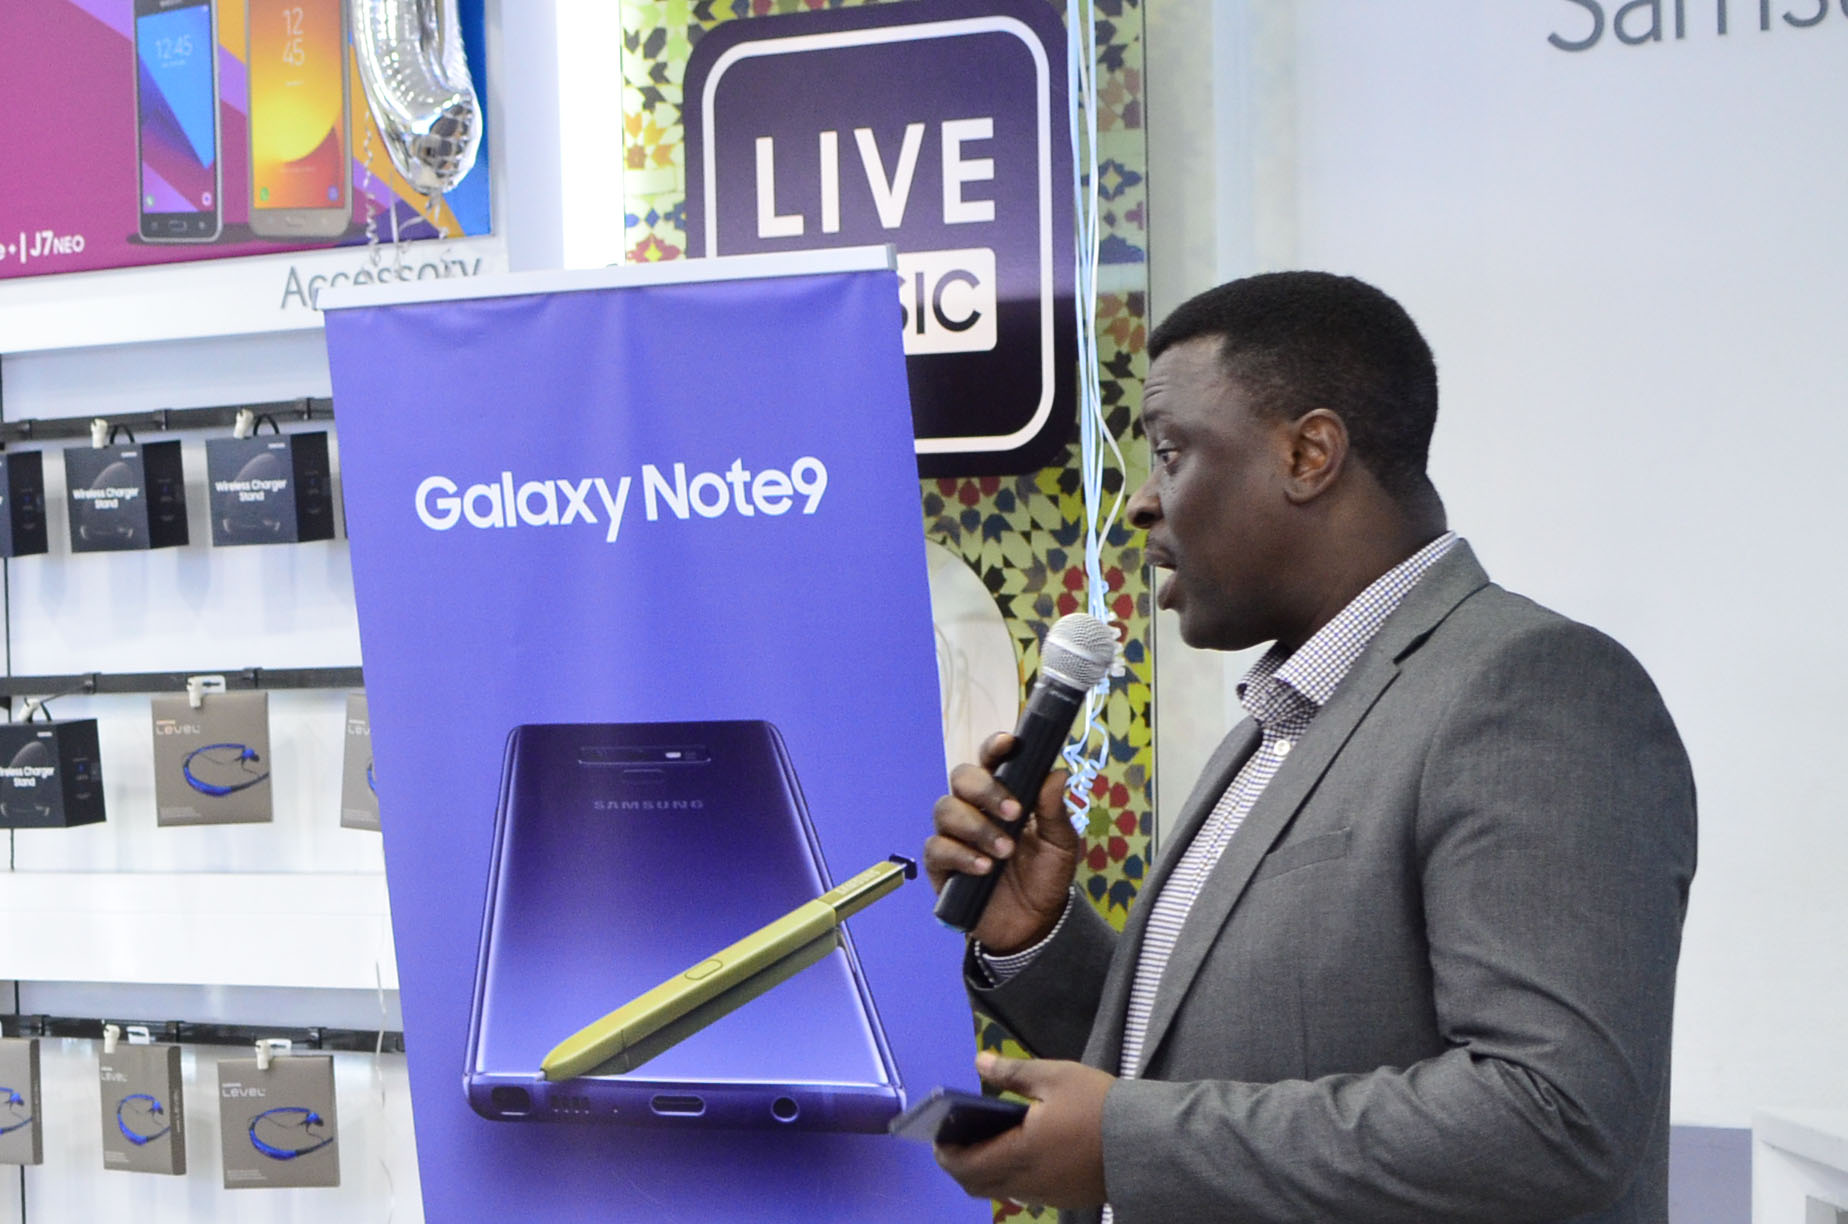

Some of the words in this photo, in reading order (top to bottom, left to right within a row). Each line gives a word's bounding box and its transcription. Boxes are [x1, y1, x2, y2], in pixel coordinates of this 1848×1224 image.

[1547, 0, 1848, 52] Sams
[755, 117, 995, 239] LIVE
[415, 471, 632, 543] Galaxy
[642, 456, 828, 521] Note9
[593, 799, 704, 810] SAMSUNG
